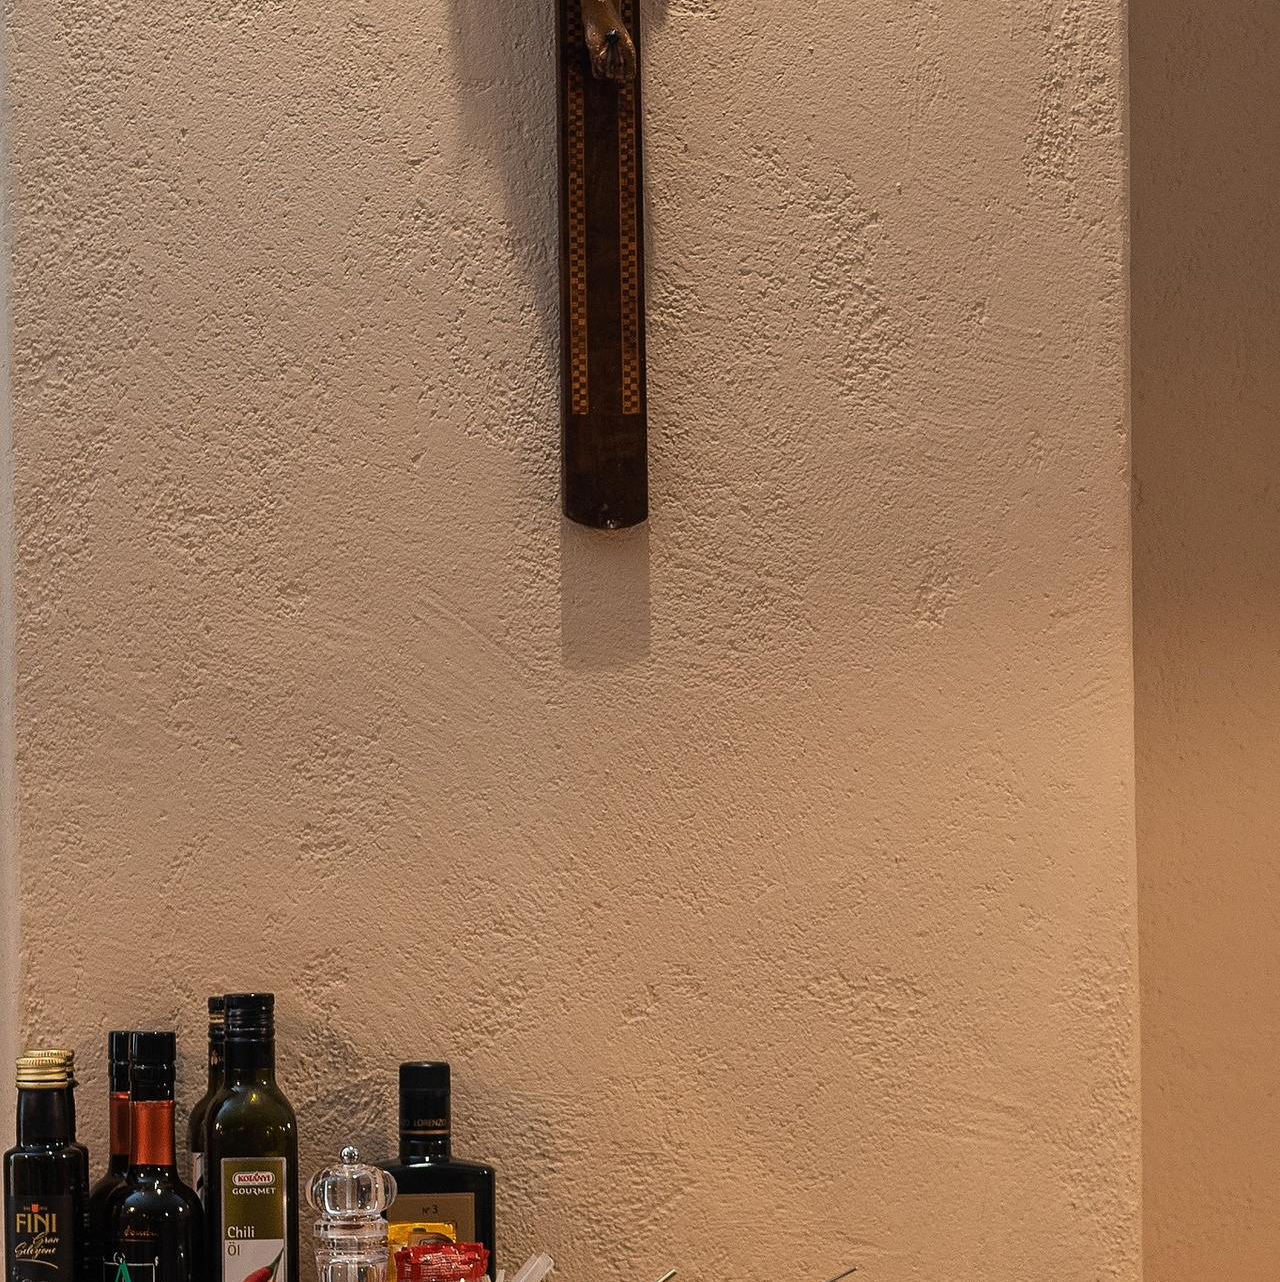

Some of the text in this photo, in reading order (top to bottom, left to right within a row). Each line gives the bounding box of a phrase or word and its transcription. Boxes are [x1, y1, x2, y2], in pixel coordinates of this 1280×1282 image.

[232, 1187, 276, 1196] GOURMET
[432, 1204, 438, 1214] 3
[16, 1213, 57, 1233] FINI
[227, 1225, 255, 1238] Chili
[227, 1241, 240, 1256] Öl
